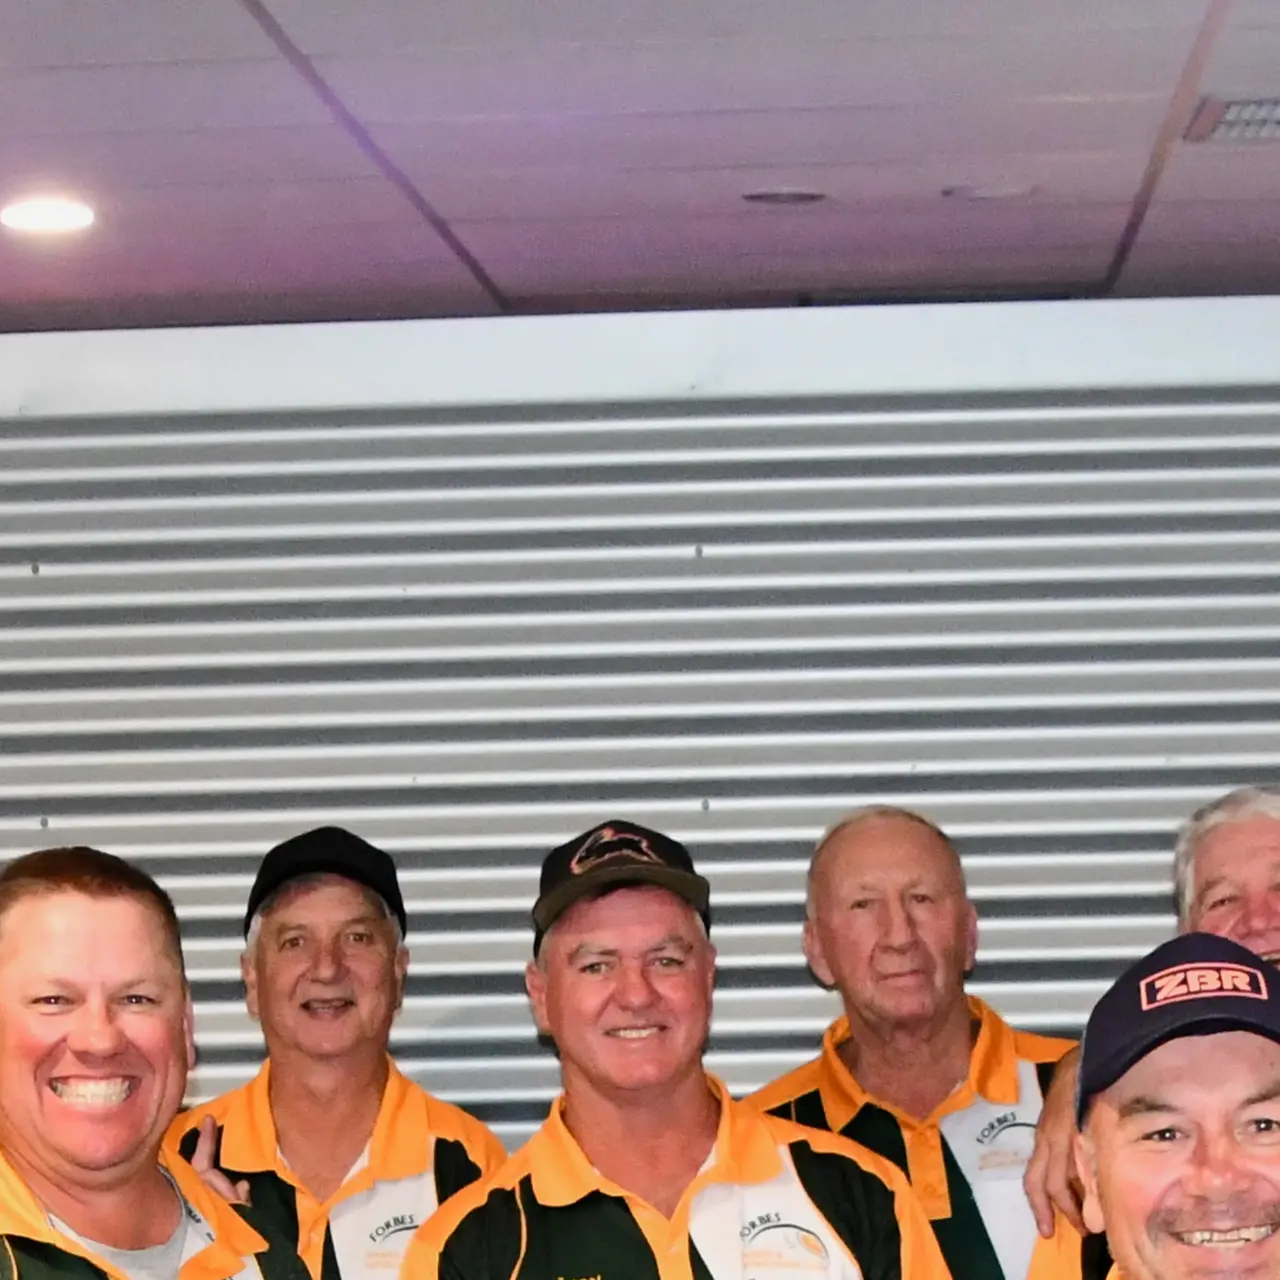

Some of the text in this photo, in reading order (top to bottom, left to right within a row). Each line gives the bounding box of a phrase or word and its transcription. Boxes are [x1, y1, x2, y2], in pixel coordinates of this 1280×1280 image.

[1154, 969, 1251, 1001] ZBR
[976, 1111, 1017, 1144] FORBES
[369, 1215, 415, 1242] FORBES
[739, 1212, 781, 1238] ORBES
